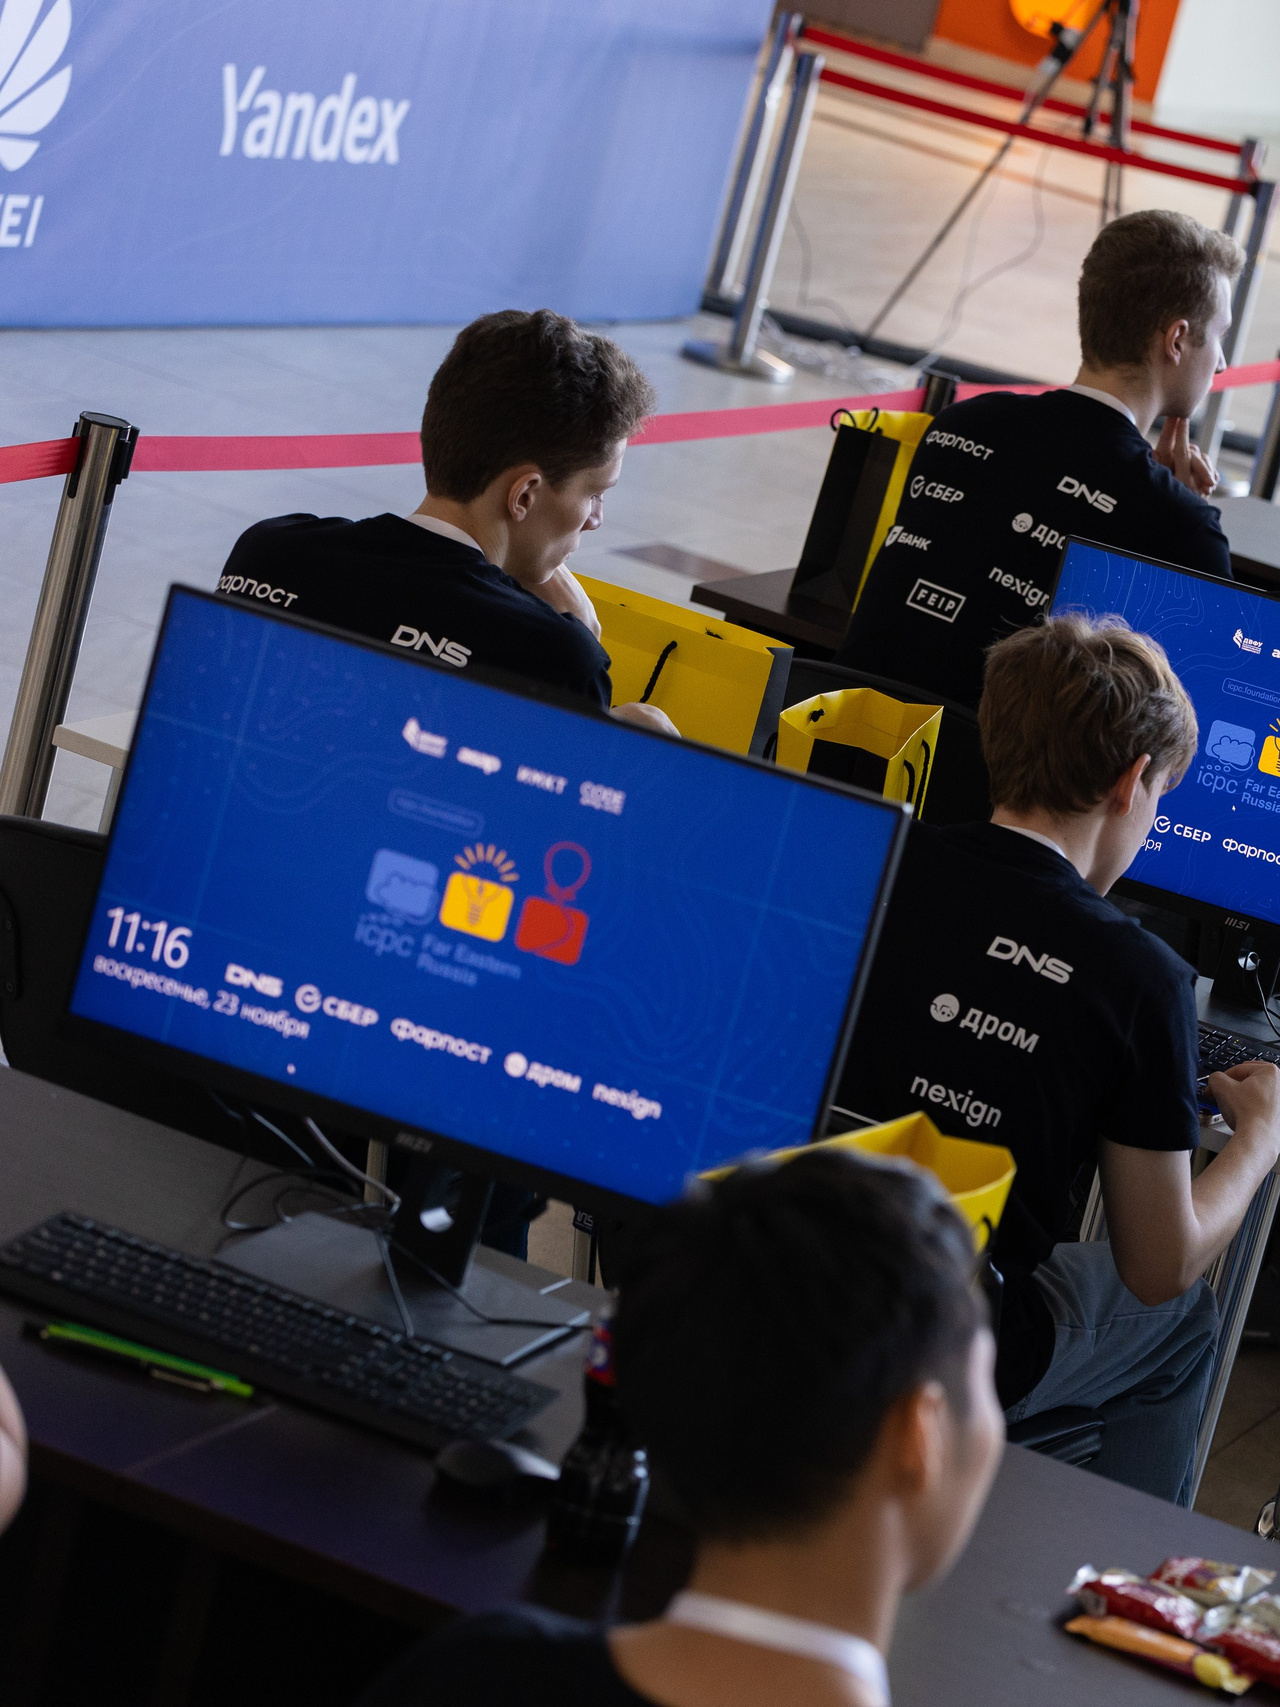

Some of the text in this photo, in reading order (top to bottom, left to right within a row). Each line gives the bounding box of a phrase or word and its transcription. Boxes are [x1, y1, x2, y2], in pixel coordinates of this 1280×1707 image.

[219, 62, 411, 166] Yandex
[926, 430, 994, 460] фарпост
[924, 482, 964, 503] СБЕР
[1056, 475, 1118, 513] DNS
[1031, 523, 1066, 550] дро
[218, 574, 299, 608] арпост
[916, 589, 956, 612] FEIP
[390, 624, 472, 668] DNS
[1197, 765, 1238, 794] icpc
[1245, 778, 1266, 795] Far
[1173, 823, 1212, 843] СБЕР
[107, 906, 193, 969] 11:16
[986, 936, 1074, 984] DNS
[93, 954, 311, 1040] воскресенье, 23 ноября
[390, 1017, 493, 1065] фарпост
[959, 1007, 1040, 1053] дром
[910, 1075, 1002, 1127] nexign
